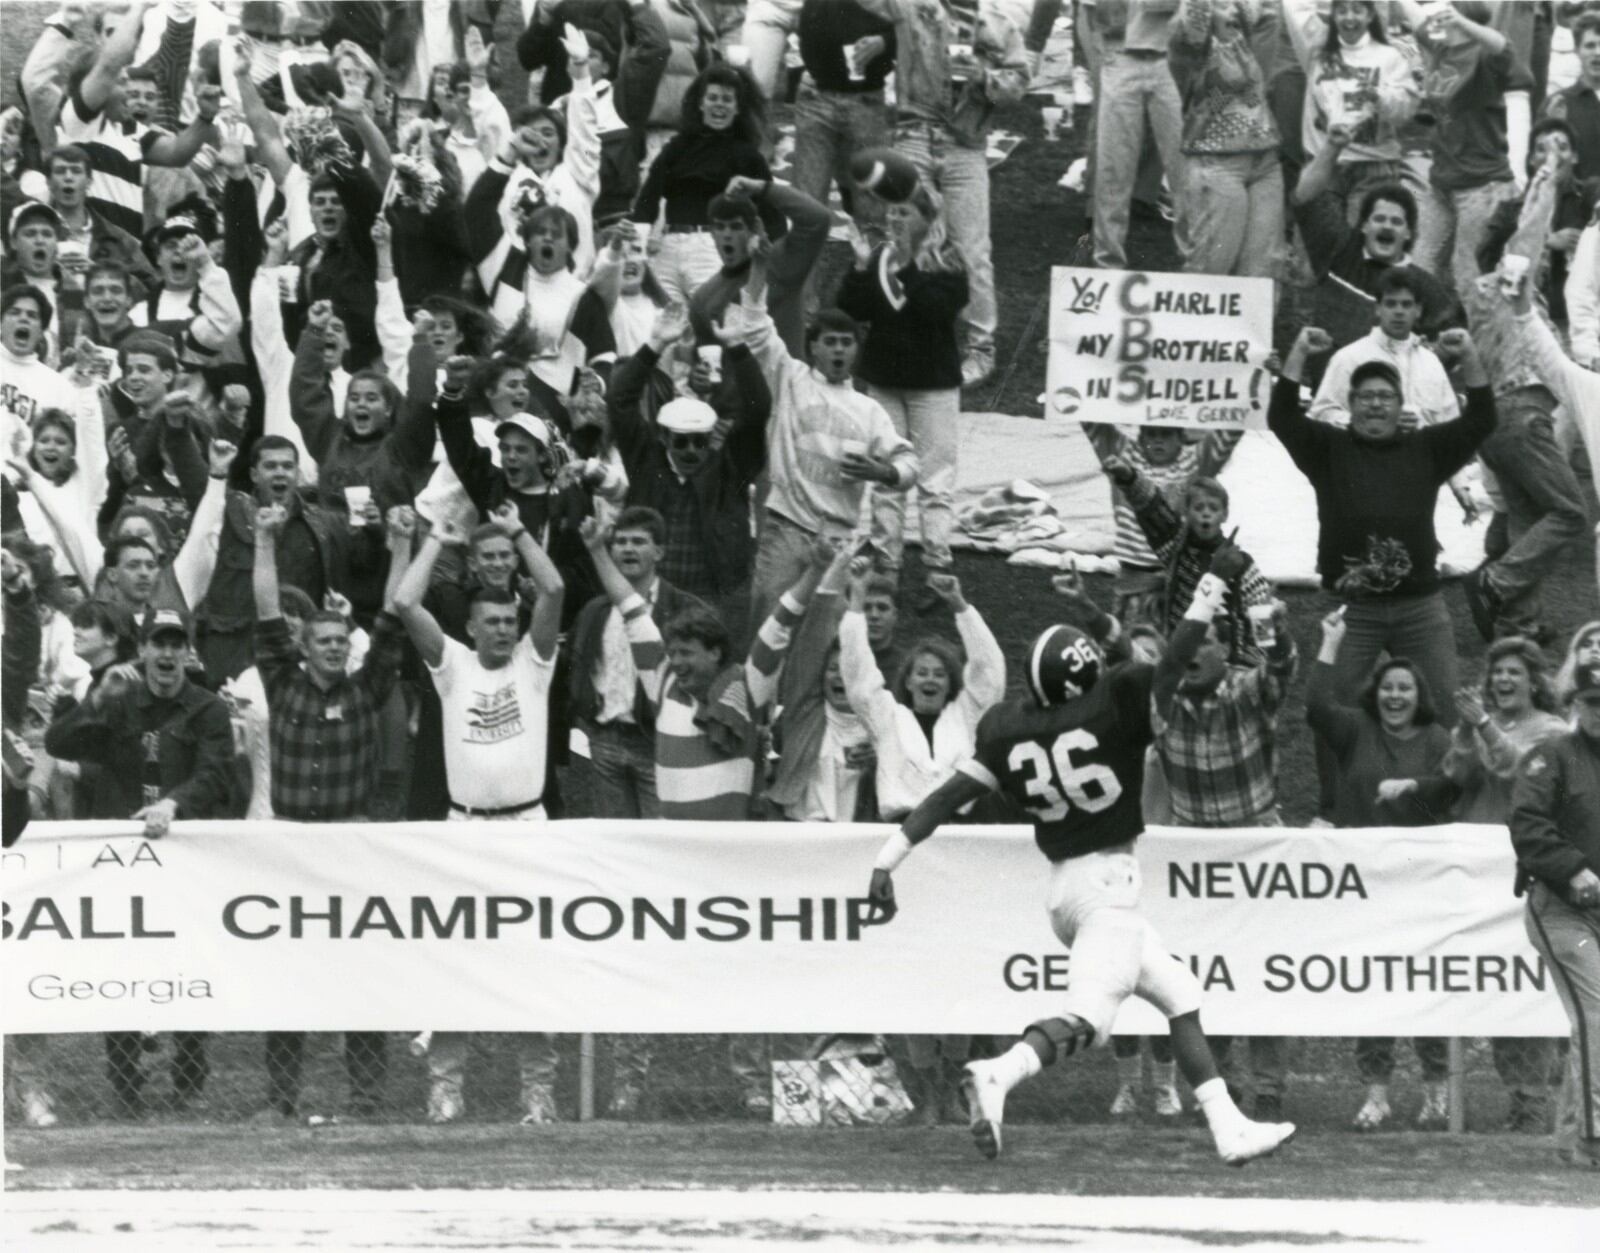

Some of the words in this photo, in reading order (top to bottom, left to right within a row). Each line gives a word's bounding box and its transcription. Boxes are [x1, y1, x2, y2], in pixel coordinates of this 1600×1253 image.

[1119, 273, 1241, 316] CHARLIE
[1076, 333, 1114, 358] MY
[1118, 317, 1250, 363] BROTHER
[1087, 377, 1112, 399] IN
[1061, 637, 1099, 672] 36
[1008, 728, 1123, 823] 36
[1168, 861, 1368, 899] NEVADA
[2, 895, 176, 940] ALL
[222, 894, 897, 942] CHAMPIONSHIP
[28, 972, 214, 1005] Georgia
[1003, 953, 1236, 992] GEIA
[1264, 954, 1546, 993] SOUTHERN
